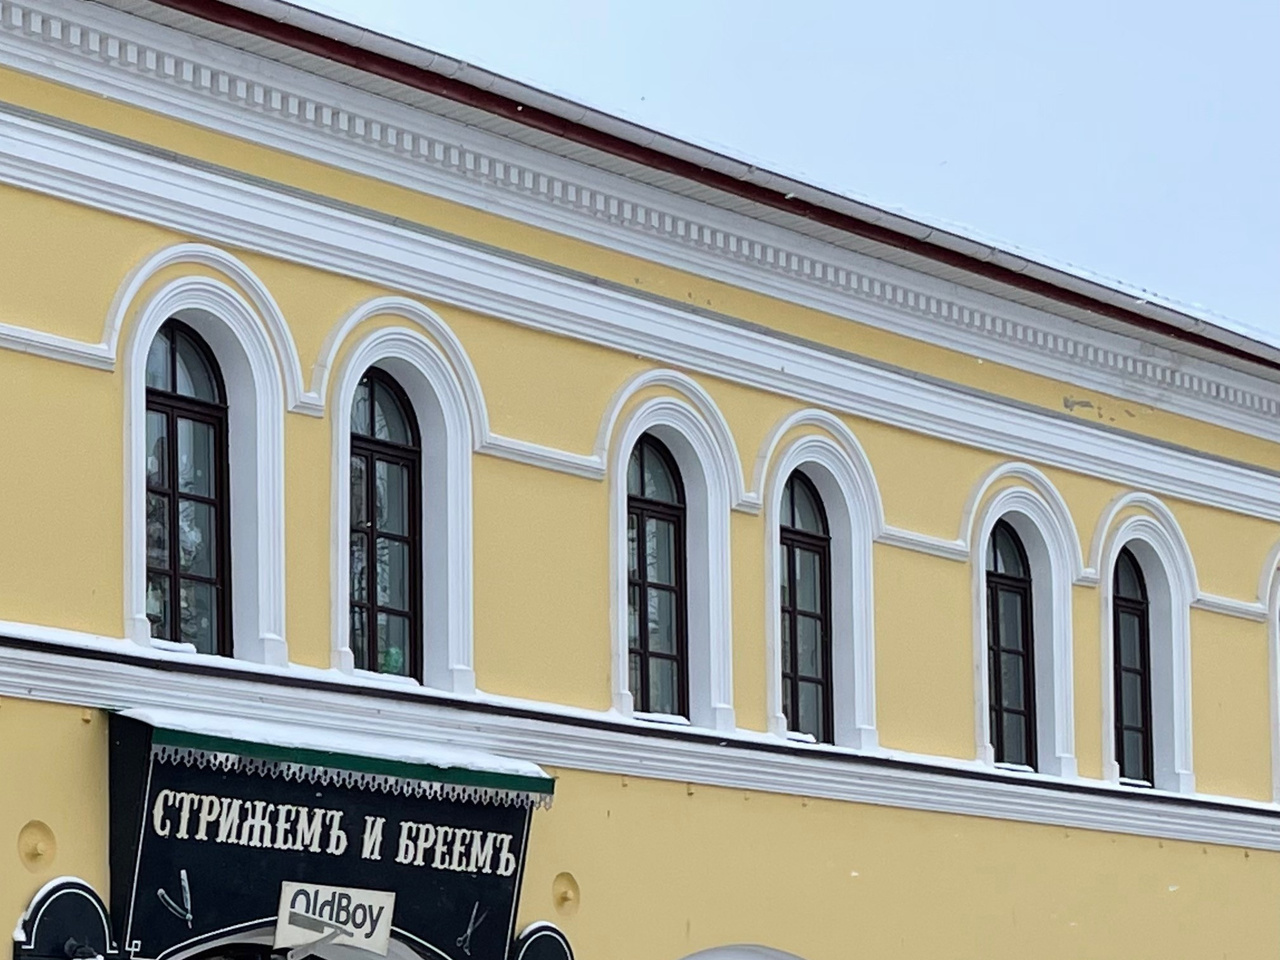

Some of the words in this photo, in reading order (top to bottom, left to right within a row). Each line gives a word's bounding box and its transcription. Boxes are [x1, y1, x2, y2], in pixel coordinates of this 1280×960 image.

[153, 789, 348, 855] СТРИЖЕМЪ
[361, 815, 386, 860] И
[395, 821, 517, 877] БРЕЕМЪ
[290, 888, 385, 939] OldBoy
